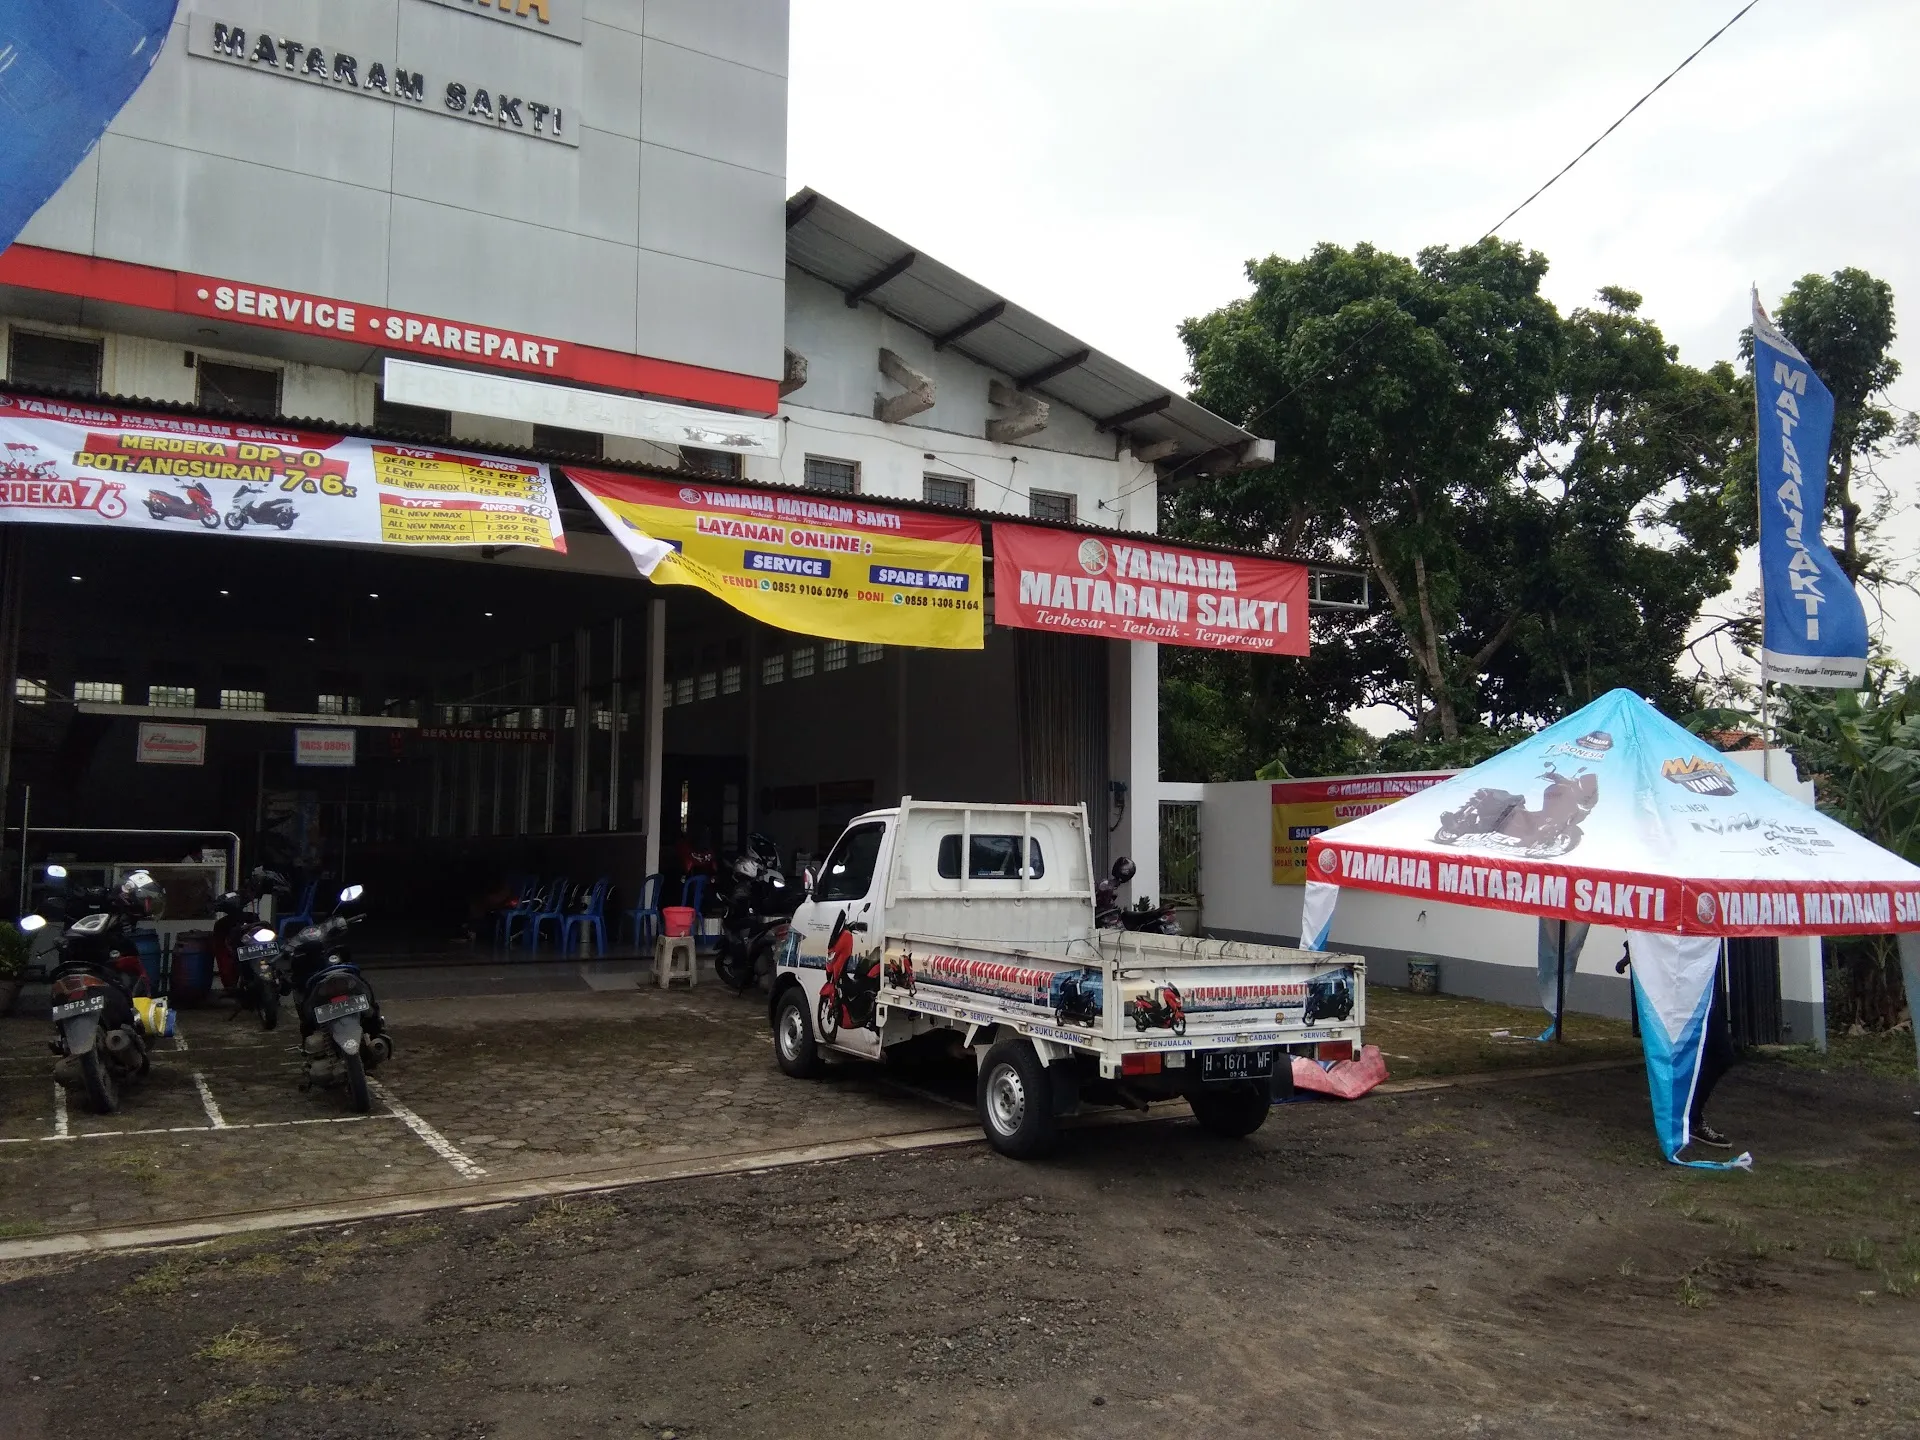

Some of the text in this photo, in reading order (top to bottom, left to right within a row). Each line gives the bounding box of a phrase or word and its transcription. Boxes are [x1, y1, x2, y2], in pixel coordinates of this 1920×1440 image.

[214, 22, 563, 136] MATARAM SAKTI
[214, 286, 558, 367] SERVICE SPAREPART
[17, 399, 117, 421] YAMAHA
[122, 415, 231, 435] MATARAM
[236, 428, 299, 442] SAKTI
[120, 433, 227, 457] MERDEKA
[238, 443, 282, 463] DP
[395, 447, 435, 459] TYPE
[137, 459, 272, 482] ANGSURAN
[385, 466, 413, 477] LEXI
[470, 477, 492, 485] 971
[498, 481, 516, 489] RB
[468, 467, 493, 477] 763
[499, 472, 518, 481] RB
[383, 477, 400, 486] ALL
[403, 481, 425, 489] NEW
[427, 483, 461, 491] AEROX
[504, 490, 522, 498] RB
[400, 499, 443, 508] TYPE
[702, 490, 901, 530] YAMAHA MATARAM SAKTI
[388, 508, 404, 516] ALL
[522, 516, 538, 524] RB
[388, 520, 404, 528] ALL
[406, 522, 428, 530] NEW
[523, 525, 540, 533] RB
[697, 517, 784, 544] LAYANAN
[789, 530, 861, 553] ONLINE
[524, 535, 540, 543] RB
[752, 554, 823, 575] SERVICE
[1111, 544, 1237, 591] YAMAHA
[722, 575, 849, 599] FENDI 0852 9106 0796
[878, 568, 964, 589] SPARE PART
[857, 590, 979, 610] DONI 0858 1308 5164
[1019, 570, 1287, 633] MATARAM SAKTI
[1036, 610, 1107, 630] Terbesar
[1121, 619, 1180, 639] Terbaik
[1194, 628, 1274, 648] Terpercaya
[421, 728, 548, 741] SERVICE COUNTER
[1341, 781, 1381, 796] YAMAHA
[1688, 804, 1710, 812] NEW
[1340, 849, 1665, 921] YAMAHA MATARAM SAKTI
[1717, 891, 1800, 925] YAMAHA
[1803, 892, 1890, 924] MATARAM
[932, 954, 970, 976] YAMAHA
[970, 960, 1020, 983] MATARAM
[1194, 983, 1308, 998] YAMAHA MATARAM SAKTI
[63, 999, 85, 1011] 5673
[90, 996, 102, 1004] CF
[915, 1000, 948, 1013] PENJUALAN
[970, 1011, 994, 1024] SERVICE
[1034, 1026, 1084, 1044] SUKU CADANG
[1148, 1039, 1192, 1048] PENJUALAN
[1303, 1031, 1330, 1039] SERVICE
[1205, 1051, 1270, 1071] H 1671 WF
